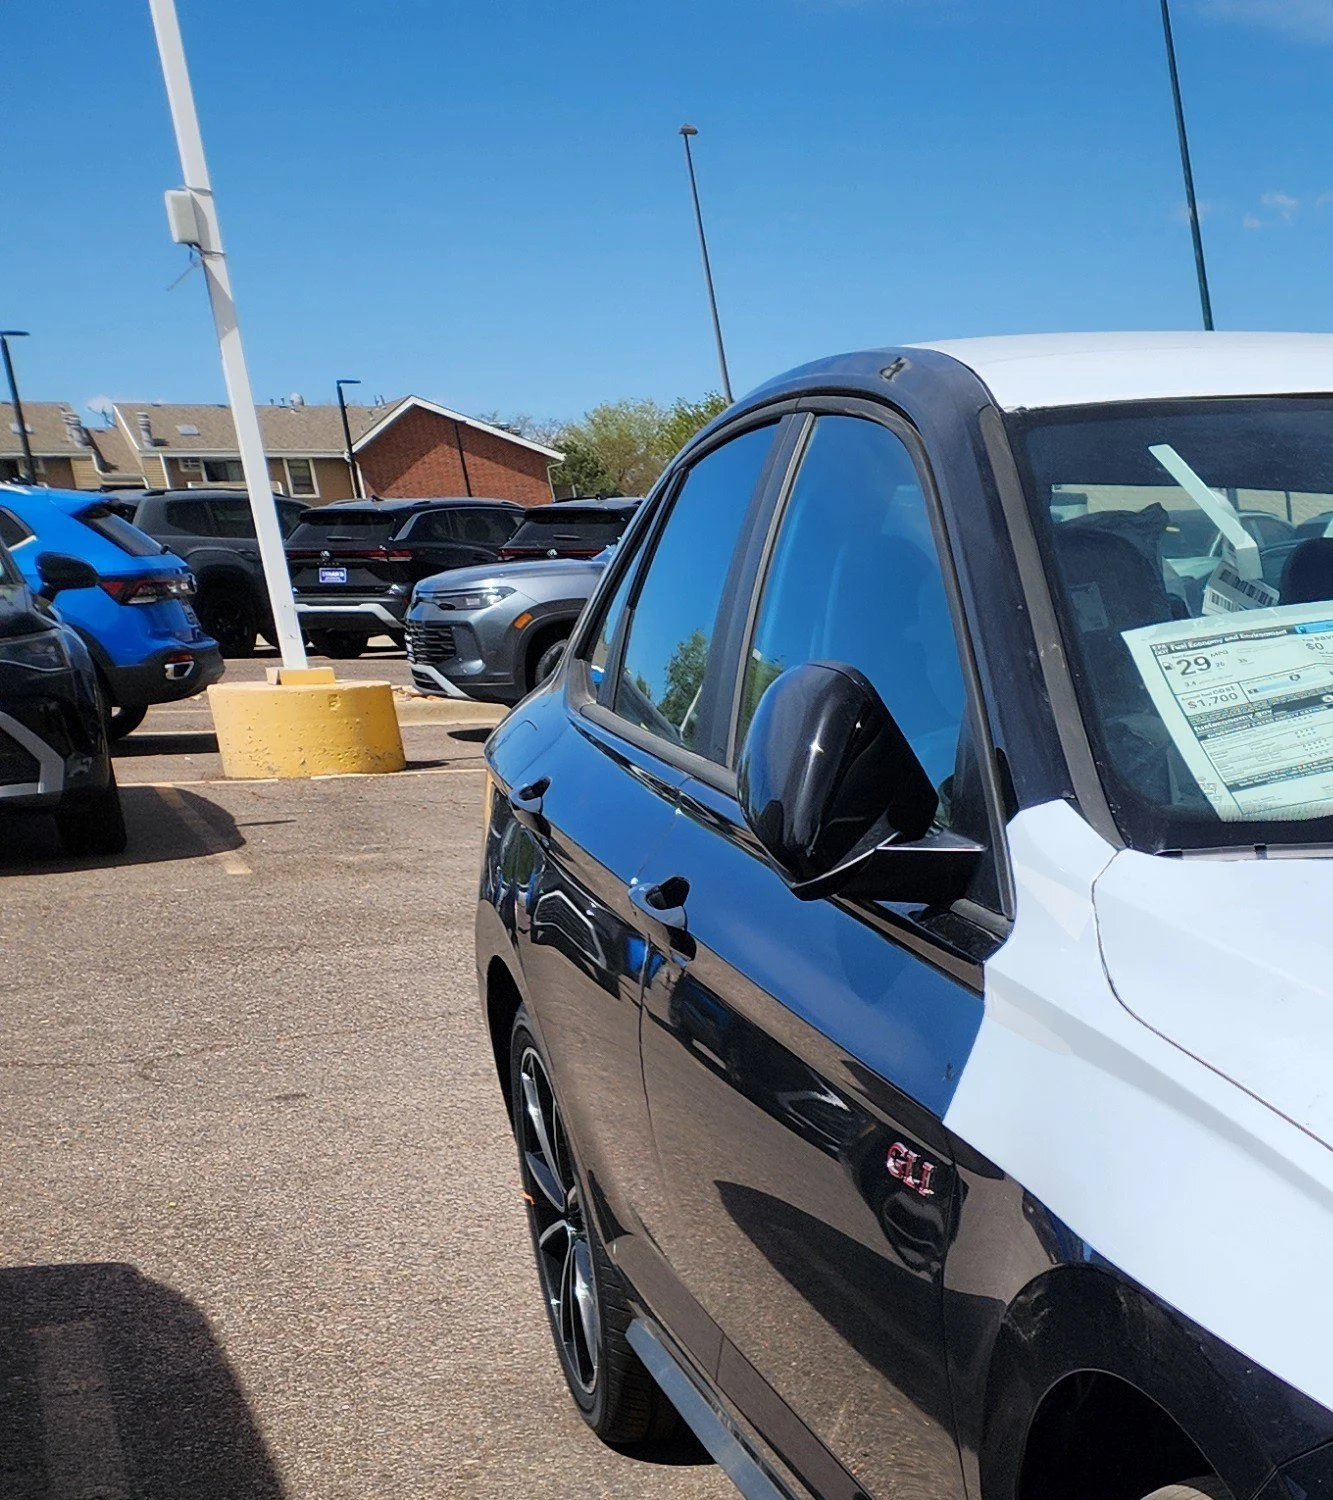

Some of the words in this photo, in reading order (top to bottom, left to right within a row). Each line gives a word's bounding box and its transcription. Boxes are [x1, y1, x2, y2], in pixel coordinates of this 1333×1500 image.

[1188, 637, 1224, 649] Economy
[1176, 656, 1212, 676] 29
[1187, 692, 1239, 709] $1,700
[886, 1142, 937, 1197] GLI
